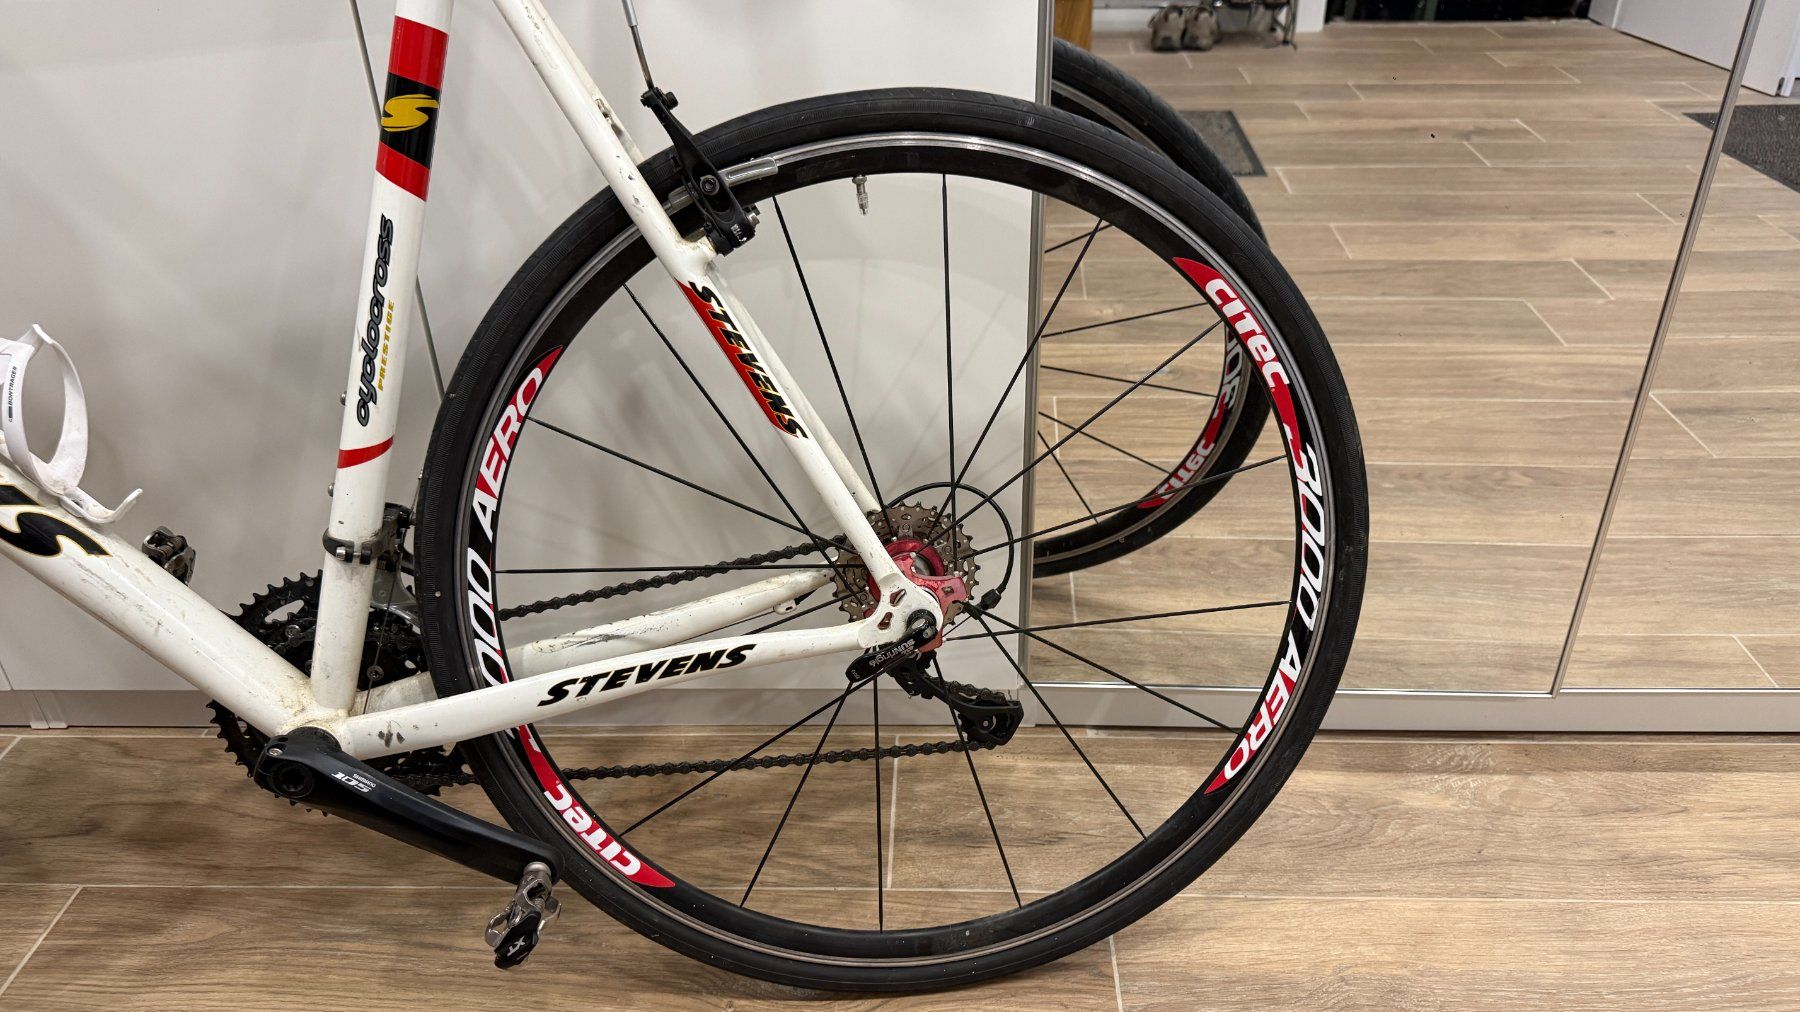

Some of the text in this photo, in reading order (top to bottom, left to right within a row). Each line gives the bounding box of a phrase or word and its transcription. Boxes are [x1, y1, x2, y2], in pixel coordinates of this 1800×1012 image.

[8, 366, 18, 406] BONTRAGER
[357, 213, 394, 427] cyclocross
[378, 299, 395, 391] PRESTIGE
[687, 280, 809, 439] STEVENS
[472, 367, 543, 543] AERO
[1283, 422, 1326, 632] 3000
[537, 643, 758, 707] STEVENS
[1224, 629, 1302, 780] AERO
[331, 771, 372, 792] 105
